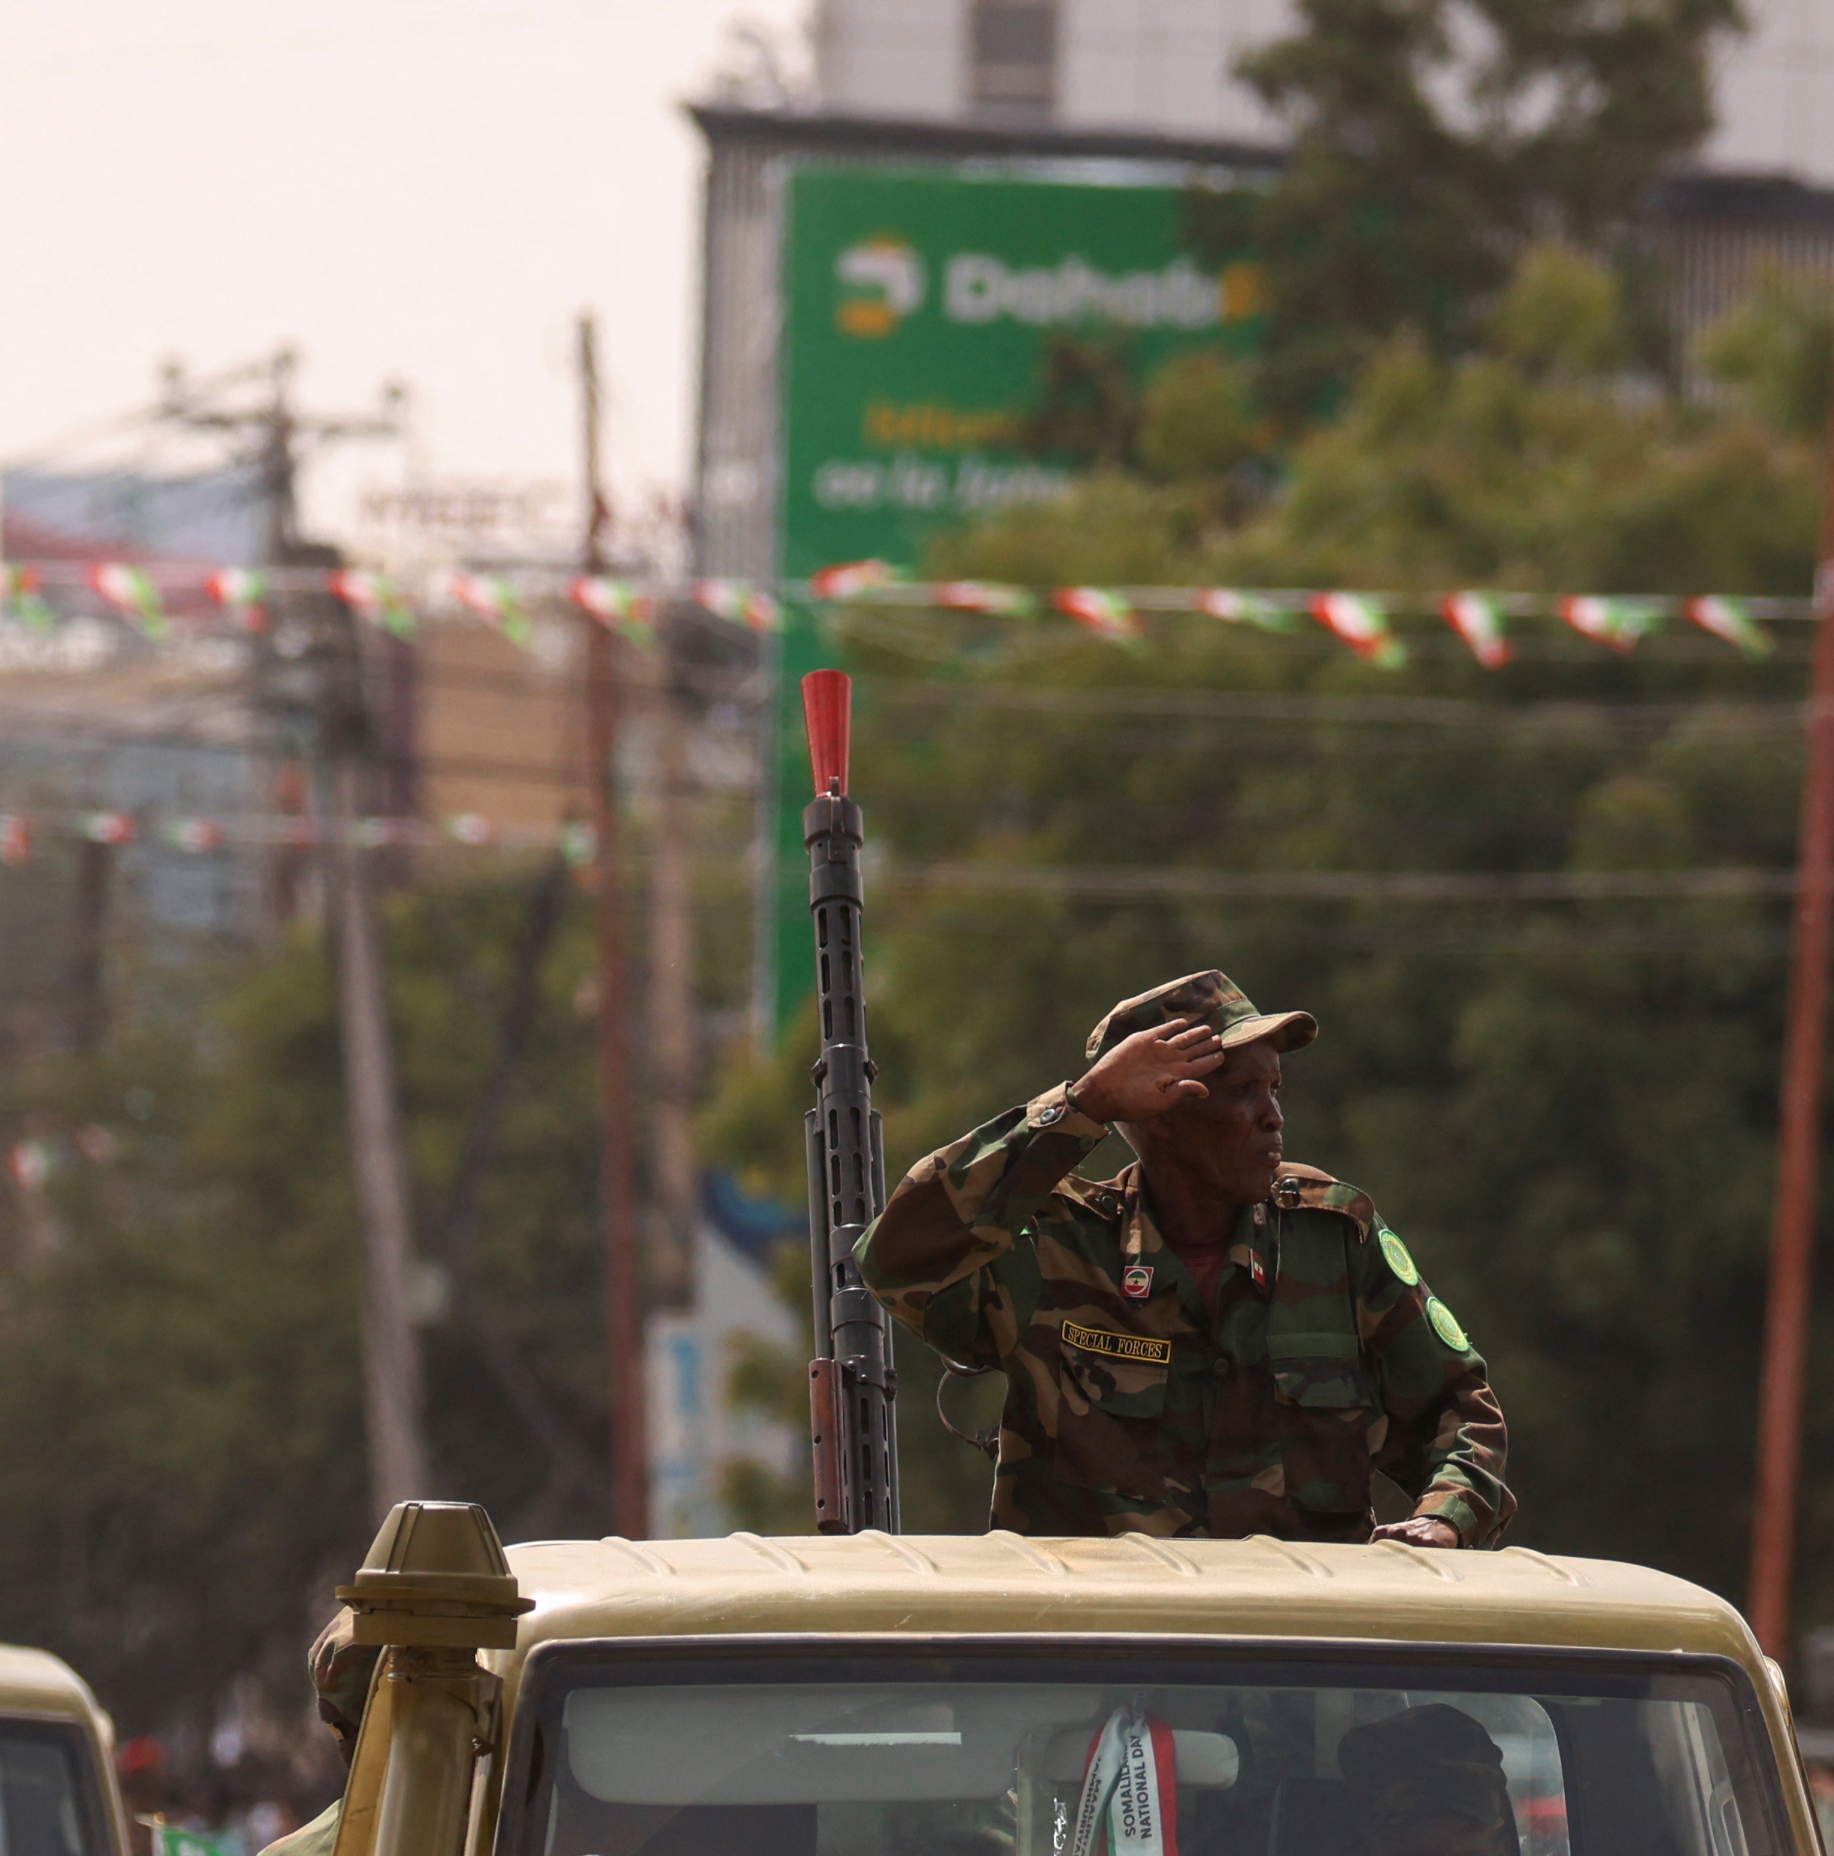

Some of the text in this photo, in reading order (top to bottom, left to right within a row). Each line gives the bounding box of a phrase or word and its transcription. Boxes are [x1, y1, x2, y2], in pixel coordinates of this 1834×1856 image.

[1067, 1326, 1163, 1359] SPECIAL FORCES
[1129, 1735, 1152, 1840] NATIONAL DAY
